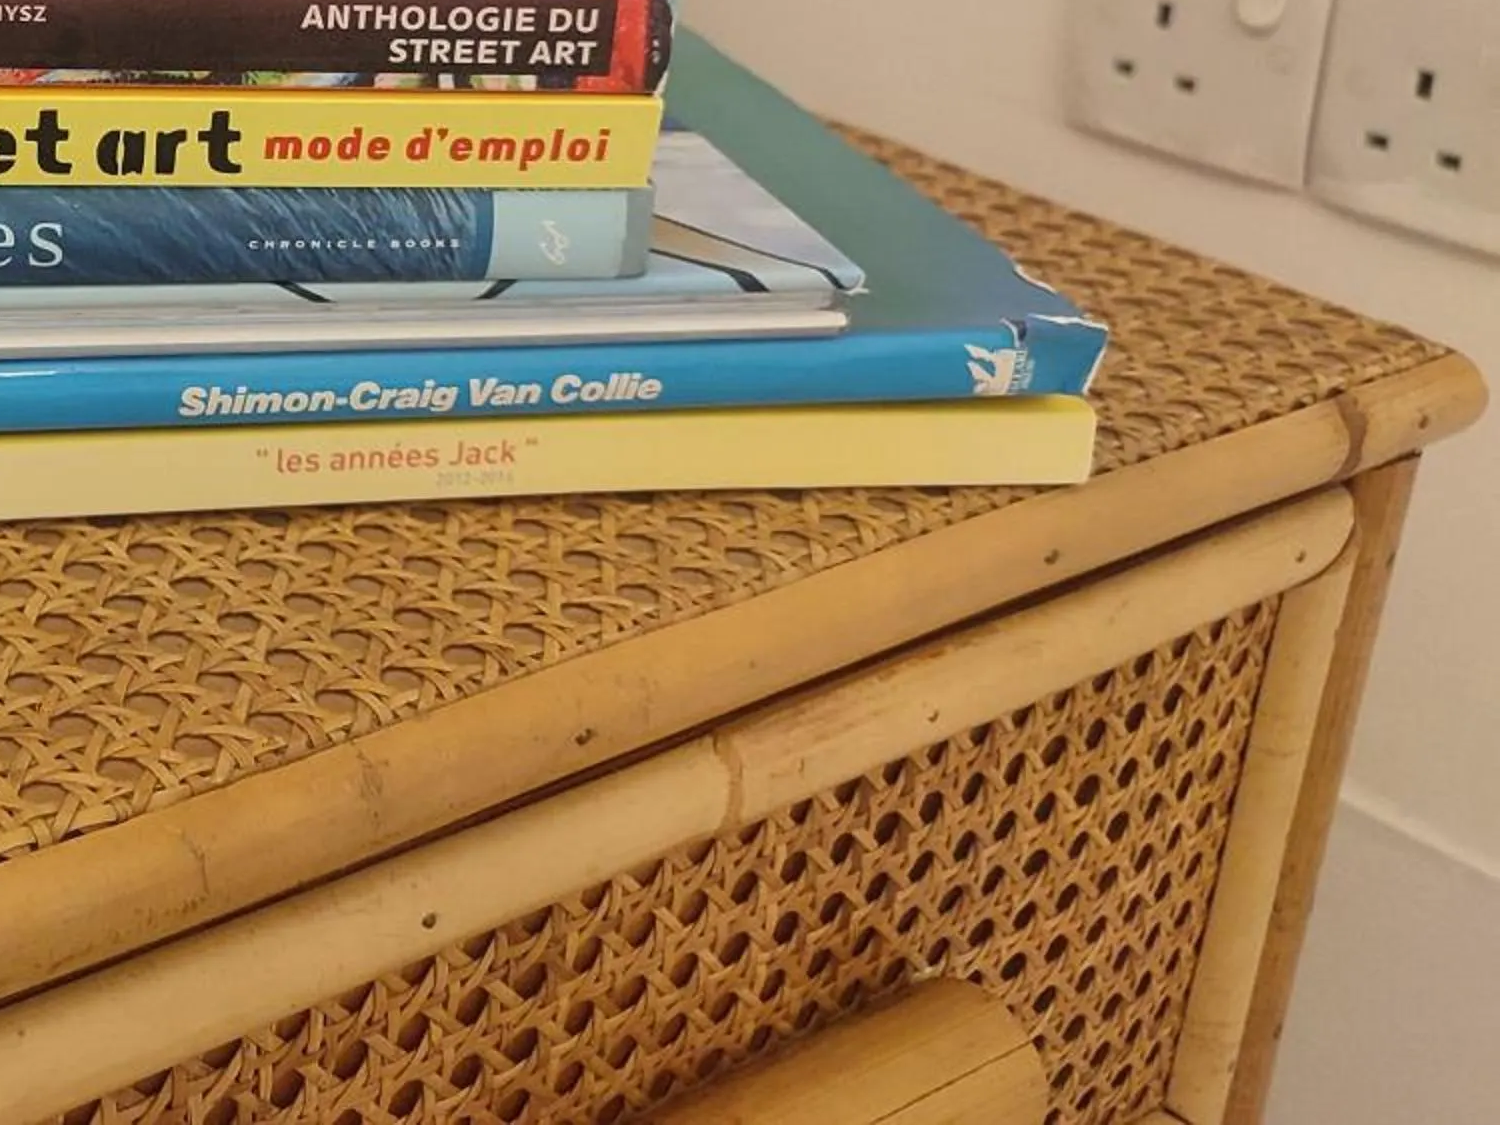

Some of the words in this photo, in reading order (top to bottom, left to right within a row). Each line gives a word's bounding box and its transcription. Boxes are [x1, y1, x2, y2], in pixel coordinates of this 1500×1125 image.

[302, 4, 539, 34] ANTHOLOGIE
[548, 7, 599, 34] DU
[388, 38, 522, 66] STREET
[529, 40, 597, 66] ART
[97, 110, 242, 176] art
[264, 127, 390, 162] mode
[405, 126, 610, 172] d'emploi
[249, 239, 376, 250] CHRONICLE
[390, 238, 461, 249] BOOKS
[178, 378, 457, 418] Shimon-Craig
[469, 377, 541, 408] Van
[552, 373, 662, 404] Collie
[329, 442, 440, 472] années
[448, 439, 516, 466] Jack
